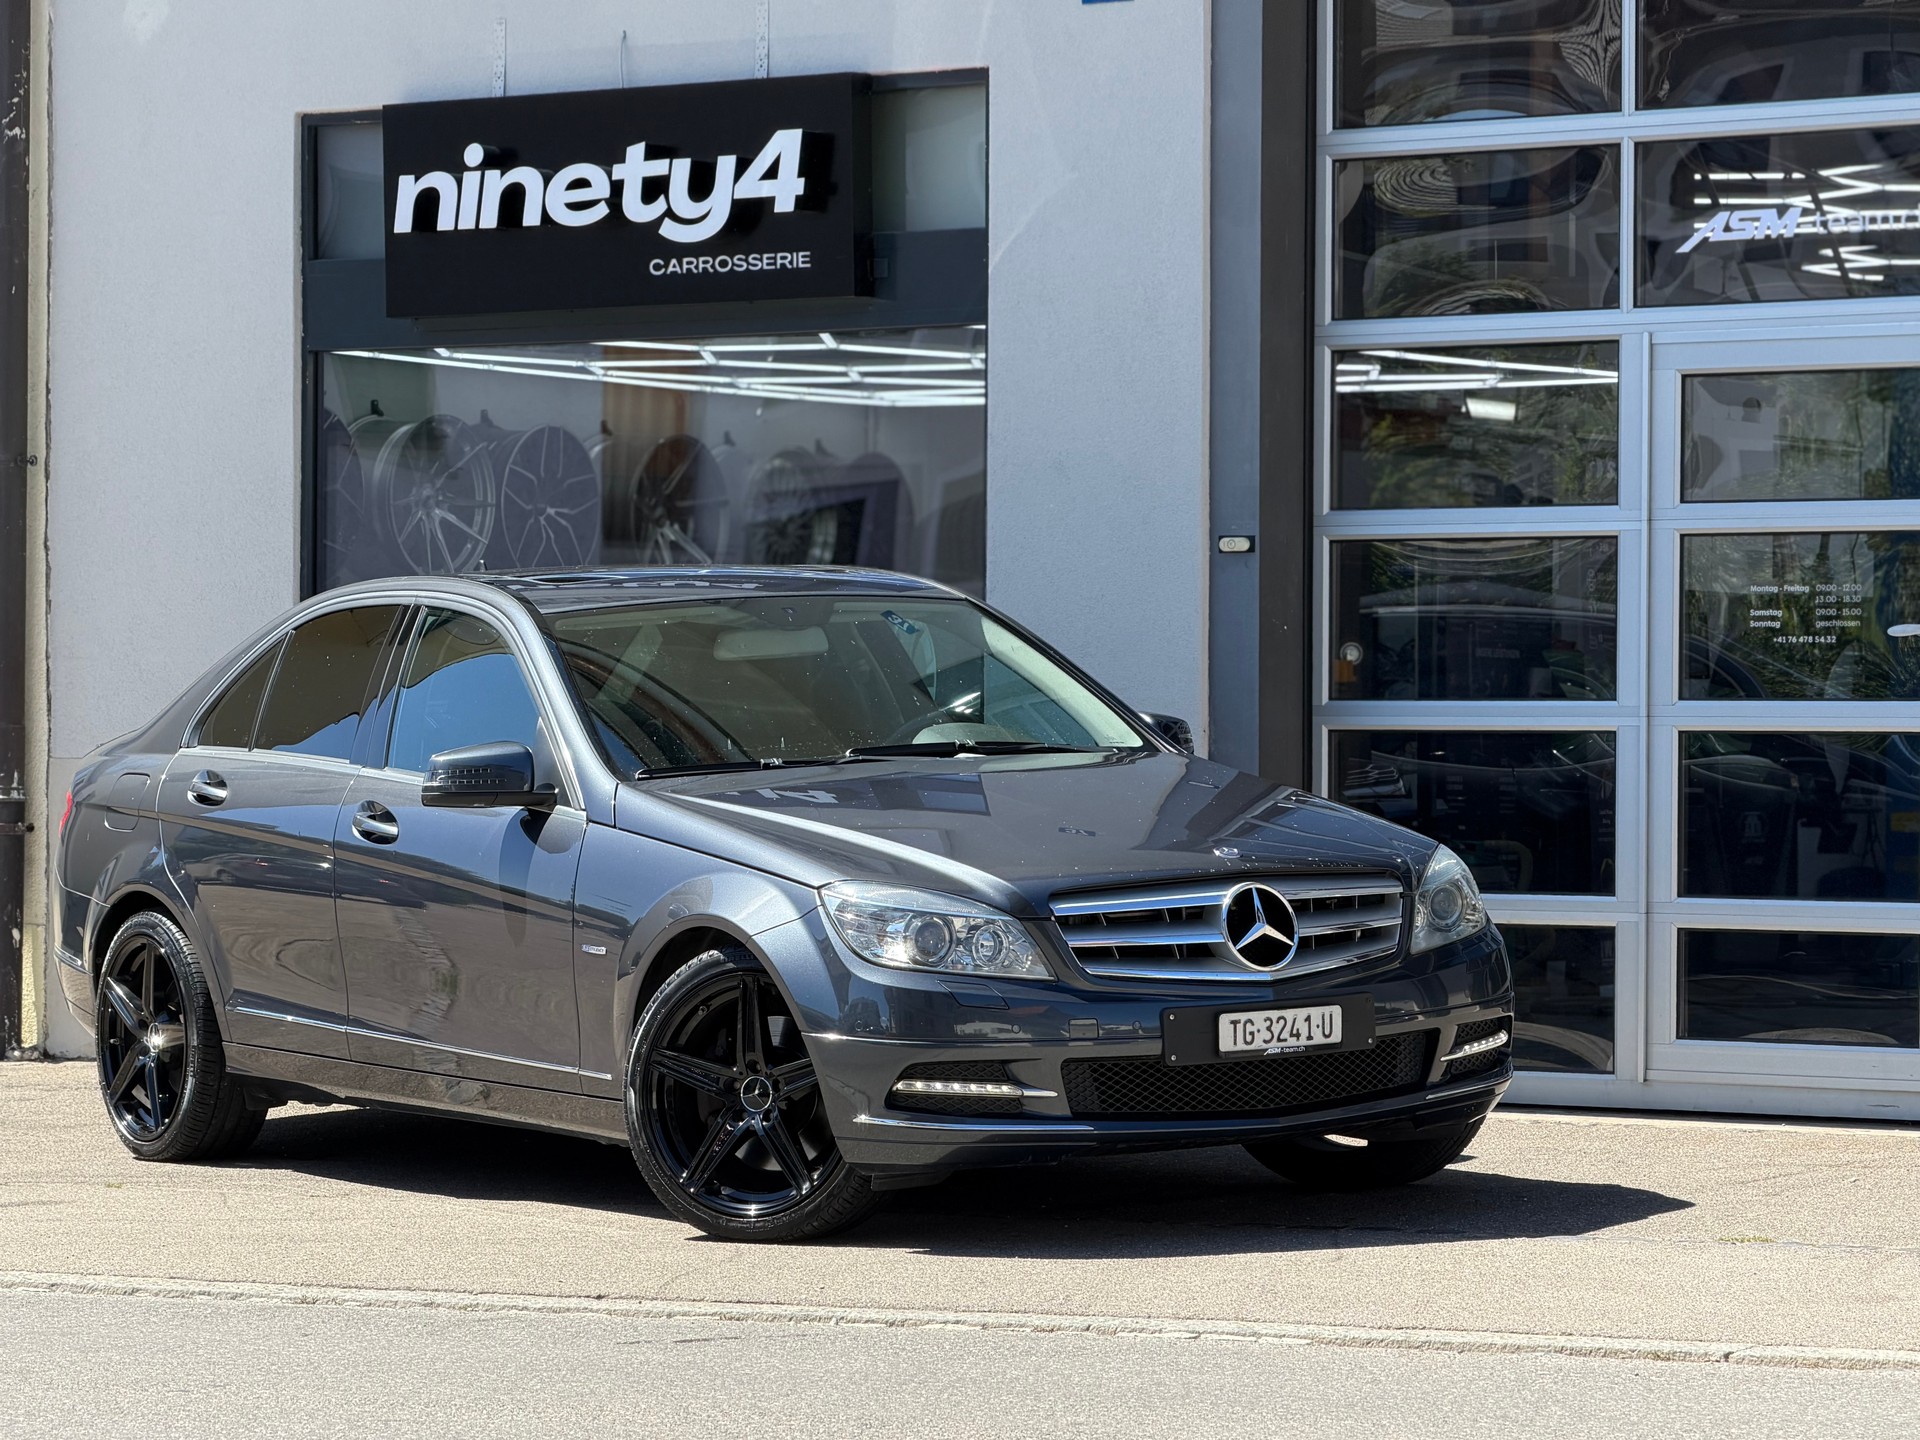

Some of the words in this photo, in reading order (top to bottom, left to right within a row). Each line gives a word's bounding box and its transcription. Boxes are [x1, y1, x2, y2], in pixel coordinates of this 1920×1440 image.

[393, 128, 805, 243] ninety4
[649, 251, 812, 276] CARROSSERIE
[1750, 585, 1779, 593] Montag
[1783, 584, 1810, 593] Freitag
[1750, 609, 1783, 617] Samstag
[1750, 620, 1781, 629] Sonntag
[1815, 619, 1860, 628] geschlossen
